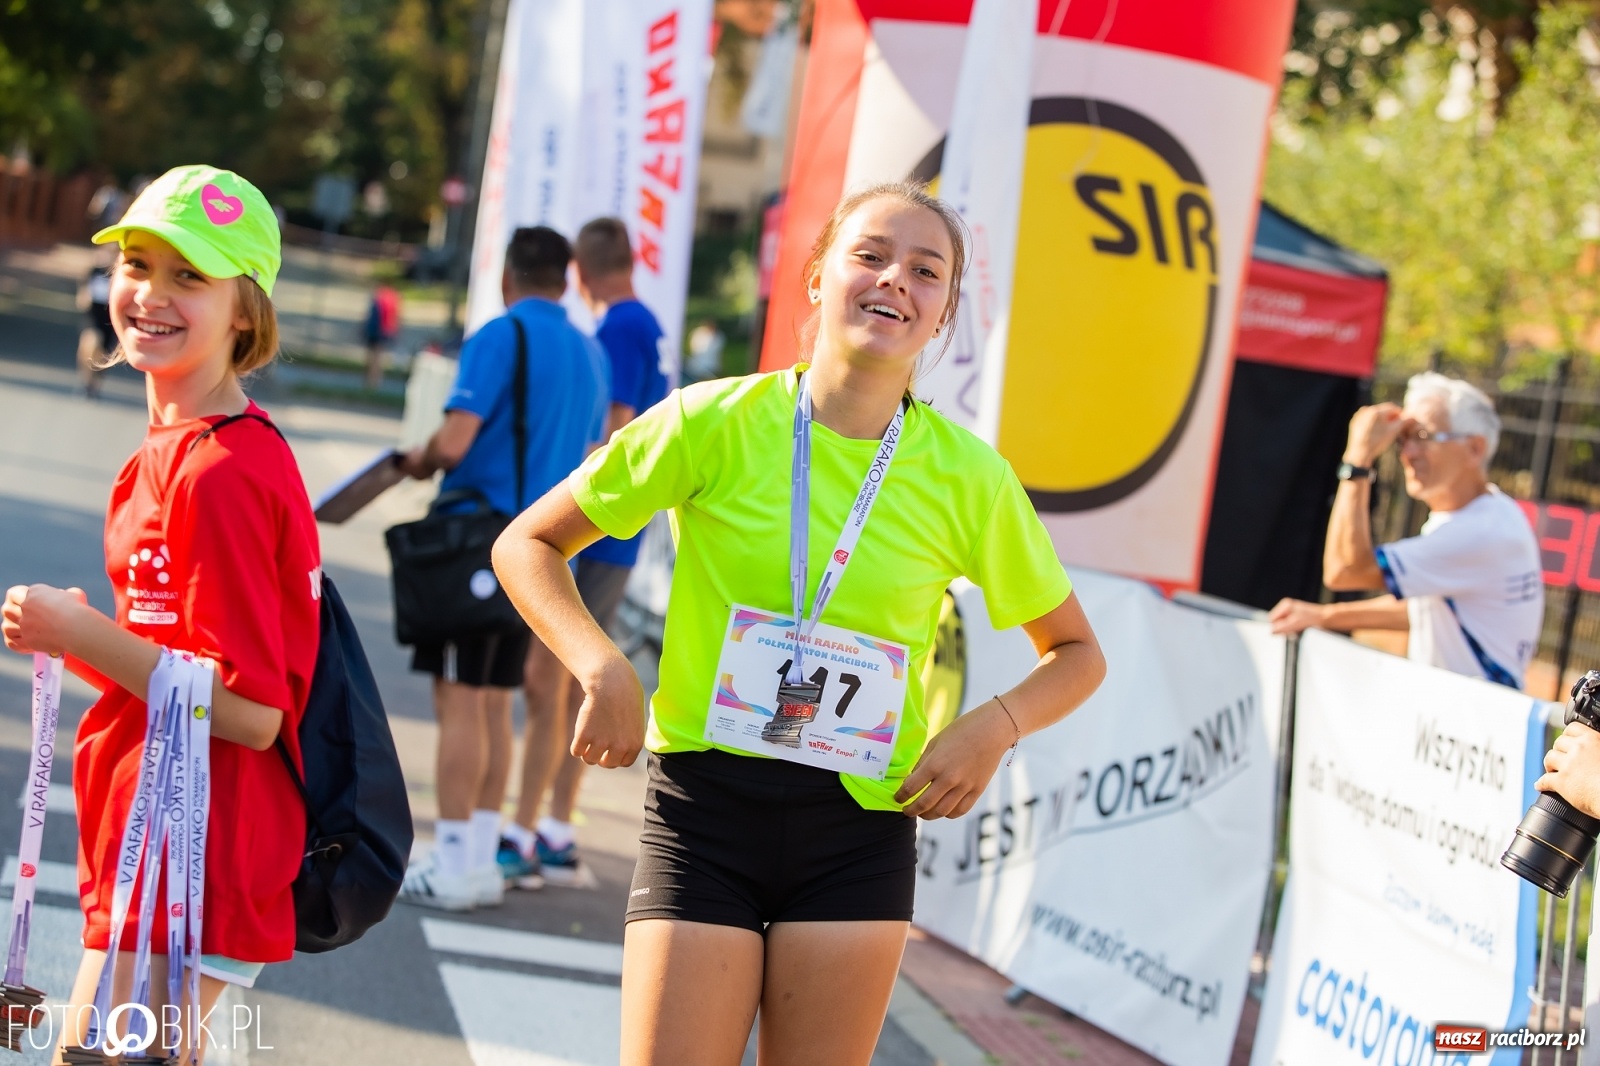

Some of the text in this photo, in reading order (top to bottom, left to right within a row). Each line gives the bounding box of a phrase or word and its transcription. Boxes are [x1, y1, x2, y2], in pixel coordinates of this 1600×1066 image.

[868, 424, 900, 483] RAFAKO
[852, 480, 871, 513] RACIBÓRZ
[854, 484, 878, 528] PÓŁMARATON
[757, 636, 881, 672] PÓŁMAATON RACIBÓRZ
[784, 630, 860, 655] MINI RAFAKO
[776, 658, 863, 719] 117
[31, 743, 54, 812] RAFAKO
[1413, 712, 1507, 792] Wszystko
[29, 816, 44, 829] V
[124, 795, 148, 870] RAFAKO
[955, 795, 1041, 872] JEST
[1381, 782, 1424, 839] domu
[190, 809, 205, 882] RAFAKO
[121, 872, 134, 885] V
[1296, 959, 1473, 1066] castora
